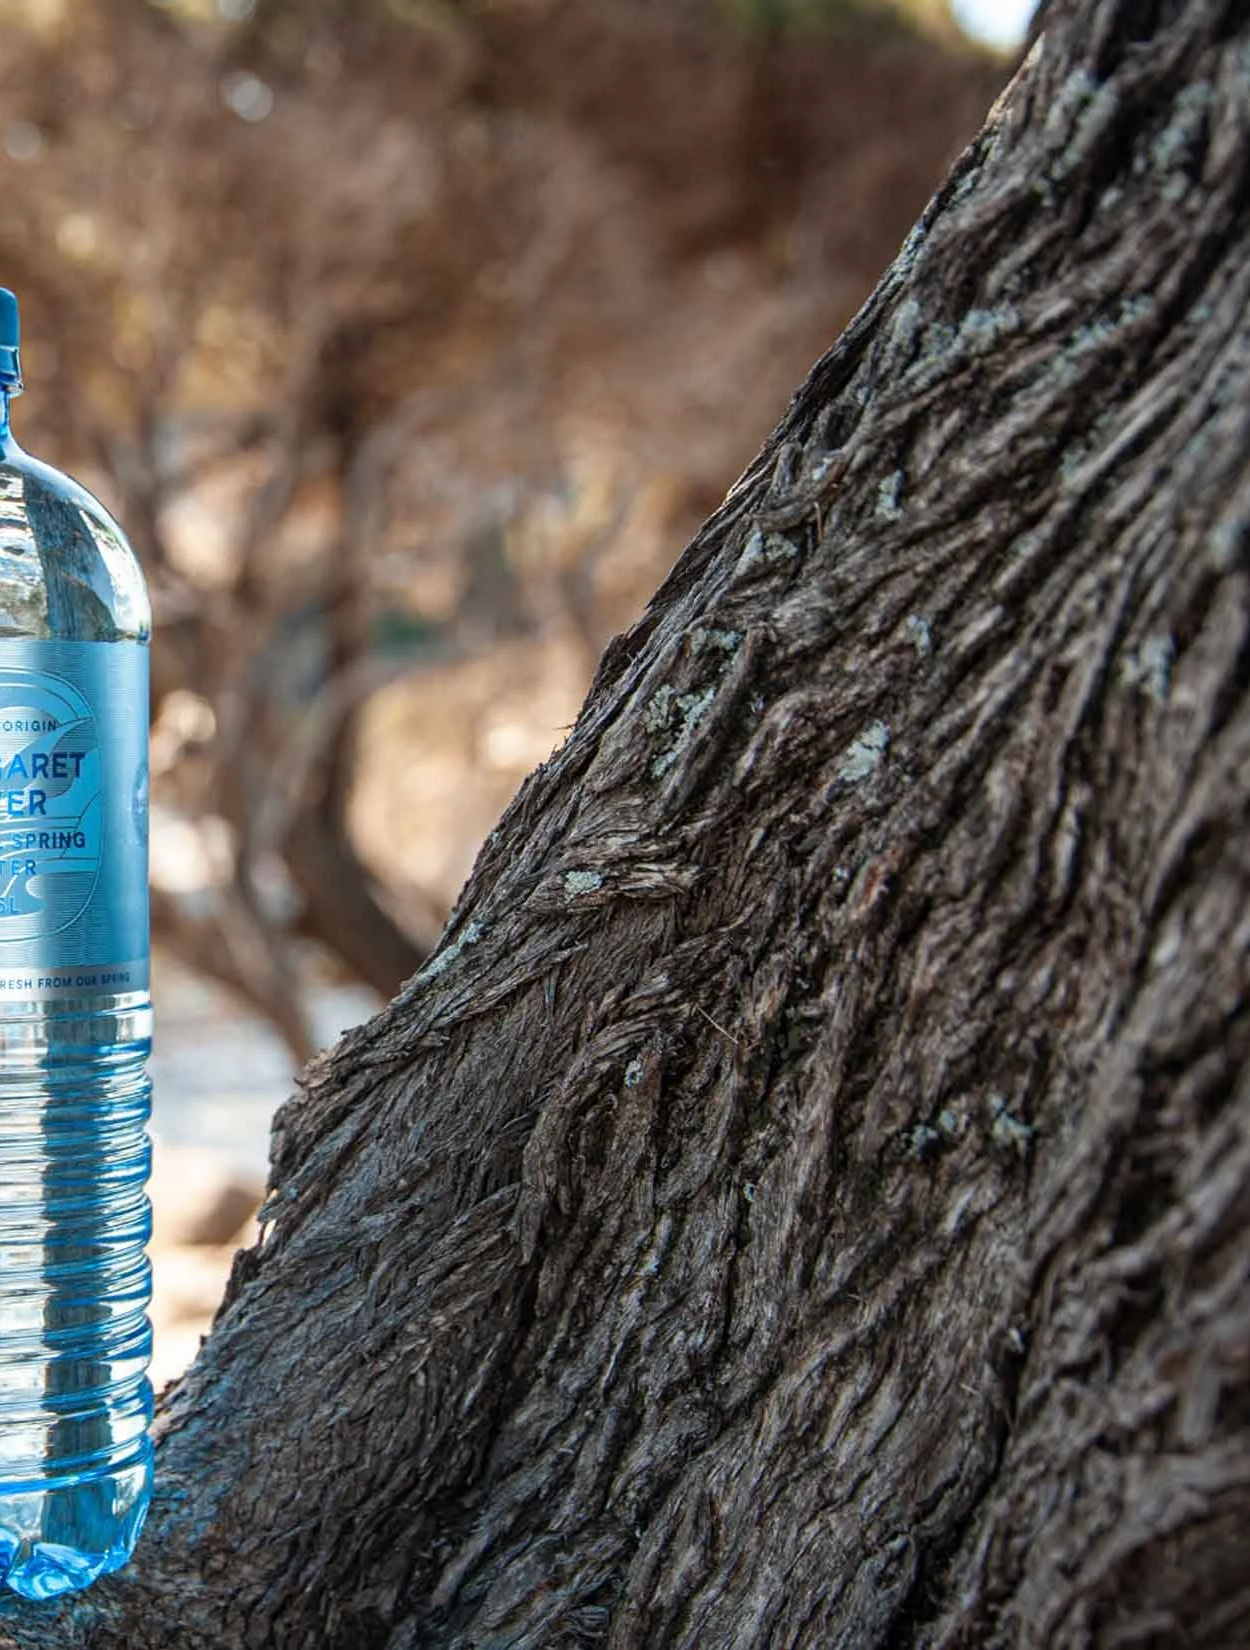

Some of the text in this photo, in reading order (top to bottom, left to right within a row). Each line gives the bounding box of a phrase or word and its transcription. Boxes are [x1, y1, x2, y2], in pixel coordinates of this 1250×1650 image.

[2, 721, 57, 732] ORIGIN
[12, 832, 86, 849] SPRING
[38, 977, 72, 988] FROM
[76, 975, 97, 986] OUR
[101, 972, 130, 984] SPRING
